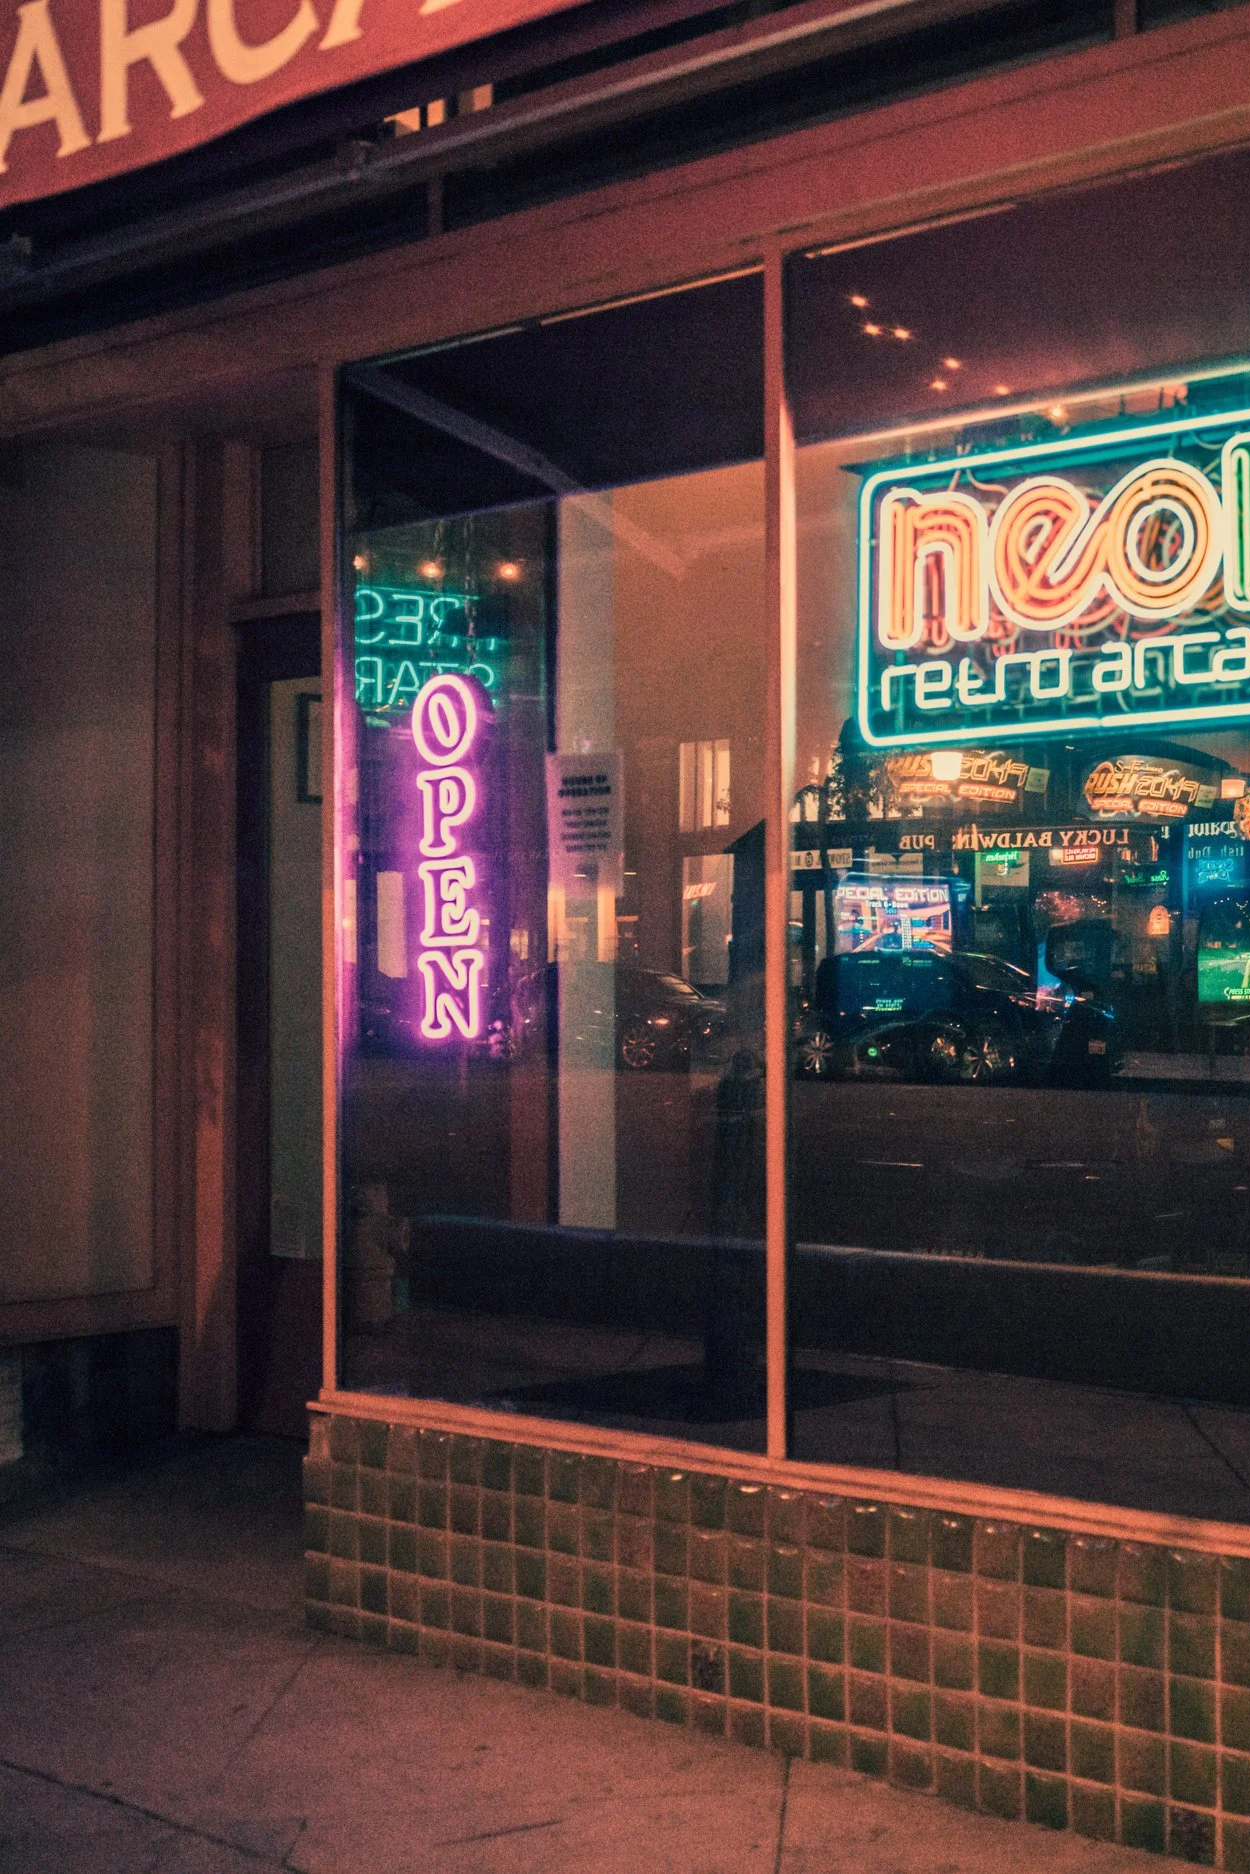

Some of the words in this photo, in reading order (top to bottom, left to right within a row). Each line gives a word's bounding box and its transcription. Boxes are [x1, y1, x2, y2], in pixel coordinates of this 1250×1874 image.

[0, 0, 464, 173] ARC
[881, 648, 1073, 712] retro
[900, 782, 952, 794] SPECIAL
[959, 784, 1017, 801] EDITION
[1085, 772, 1139, 795] RUSH
[1134, 774, 1200, 803] 2049
[1091, 798, 1134, 811] SPECIAL
[1139, 800, 1188, 815] EDITION
[411, 673, 484, 1040] OPEN
[836, 886, 889, 901] PECIAL
[893, 887, 950, 902] EDITION
